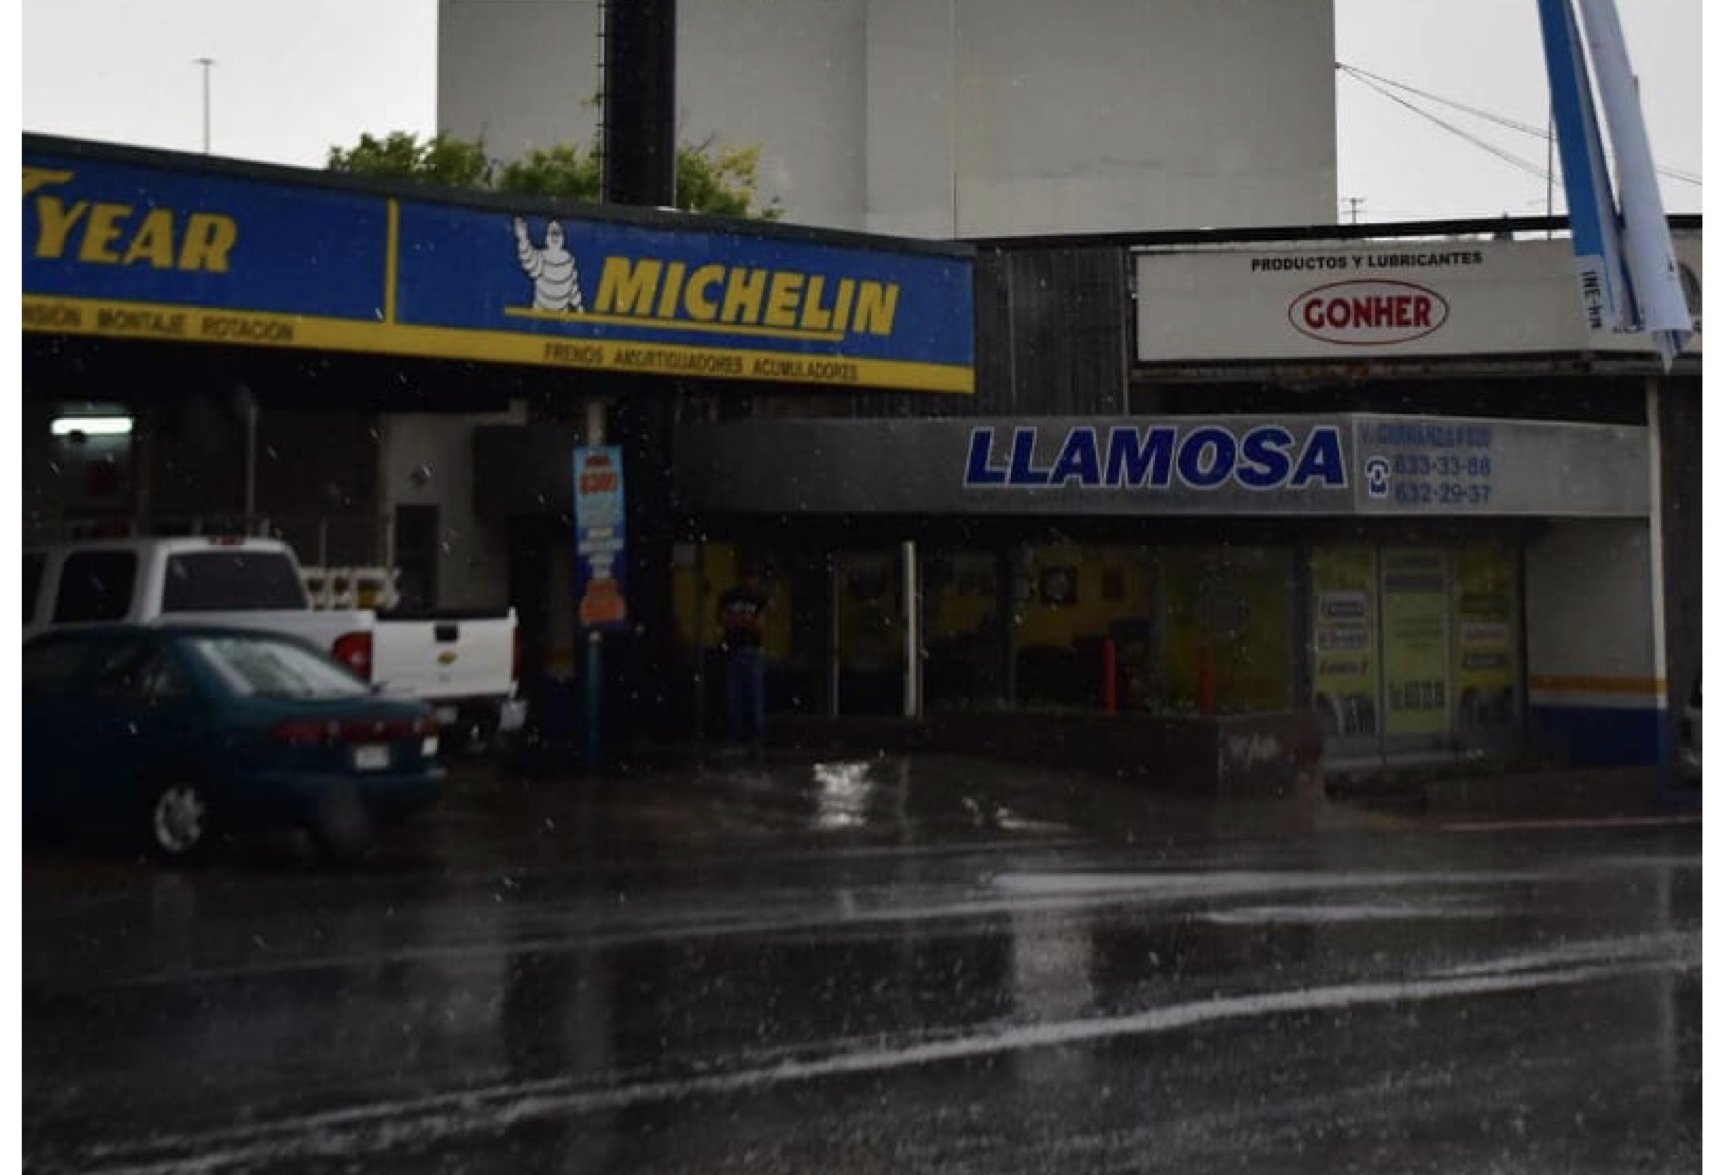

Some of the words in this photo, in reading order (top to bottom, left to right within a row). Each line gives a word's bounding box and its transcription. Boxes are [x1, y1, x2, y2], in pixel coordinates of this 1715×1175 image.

[1251, 255, 1347, 272] PRODUCTOS
[1352, 255, 1363, 269] Y
[1368, 251, 1483, 269] LUBRICANTES
[593, 255, 900, 336] MICHELIN
[1303, 294, 1433, 329] GONHER
[544, 342, 604, 365] FRENOS
[614, 347, 743, 376] AMORTIGUADORES
[753, 357, 859, 382] ACUMULADORES
[963, 424, 1349, 491] LLAMOSA
